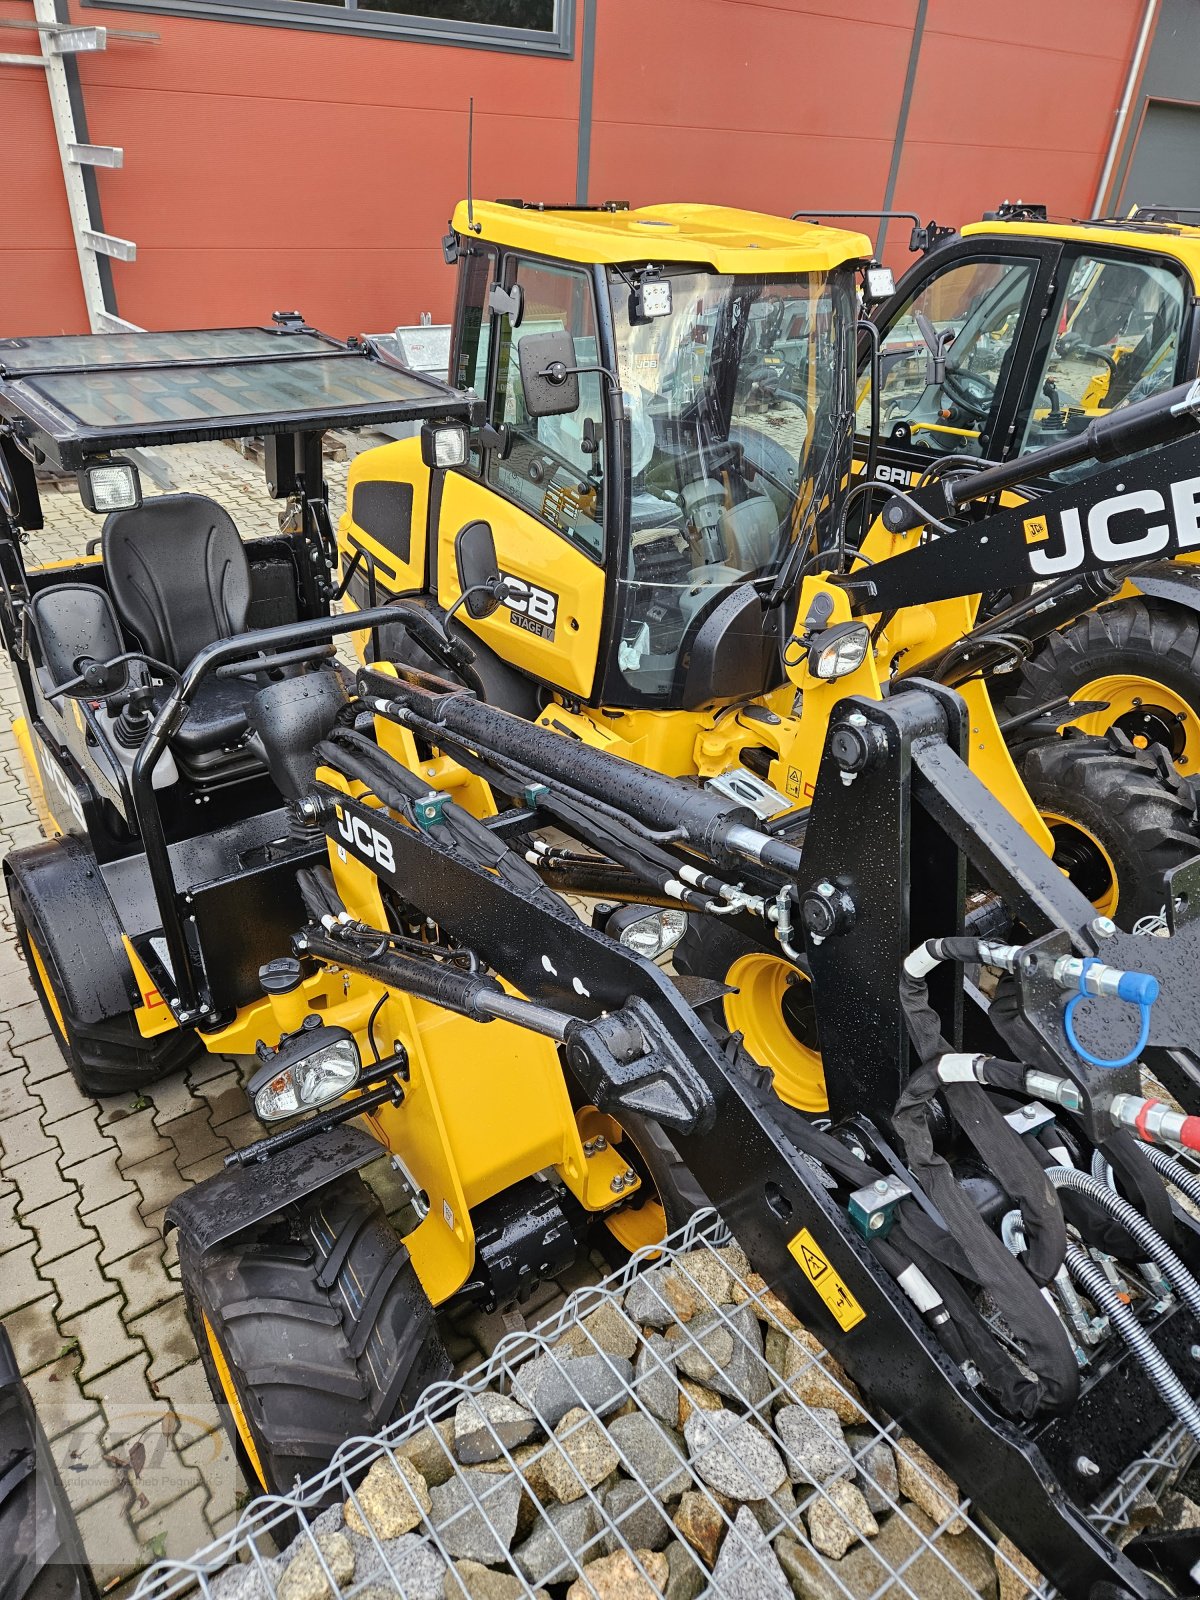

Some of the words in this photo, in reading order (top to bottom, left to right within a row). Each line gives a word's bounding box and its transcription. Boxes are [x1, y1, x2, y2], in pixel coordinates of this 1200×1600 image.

[511, 613, 541, 636] STAGE
[41, 745, 88, 833] JCB
[338, 809, 396, 874] JCB
